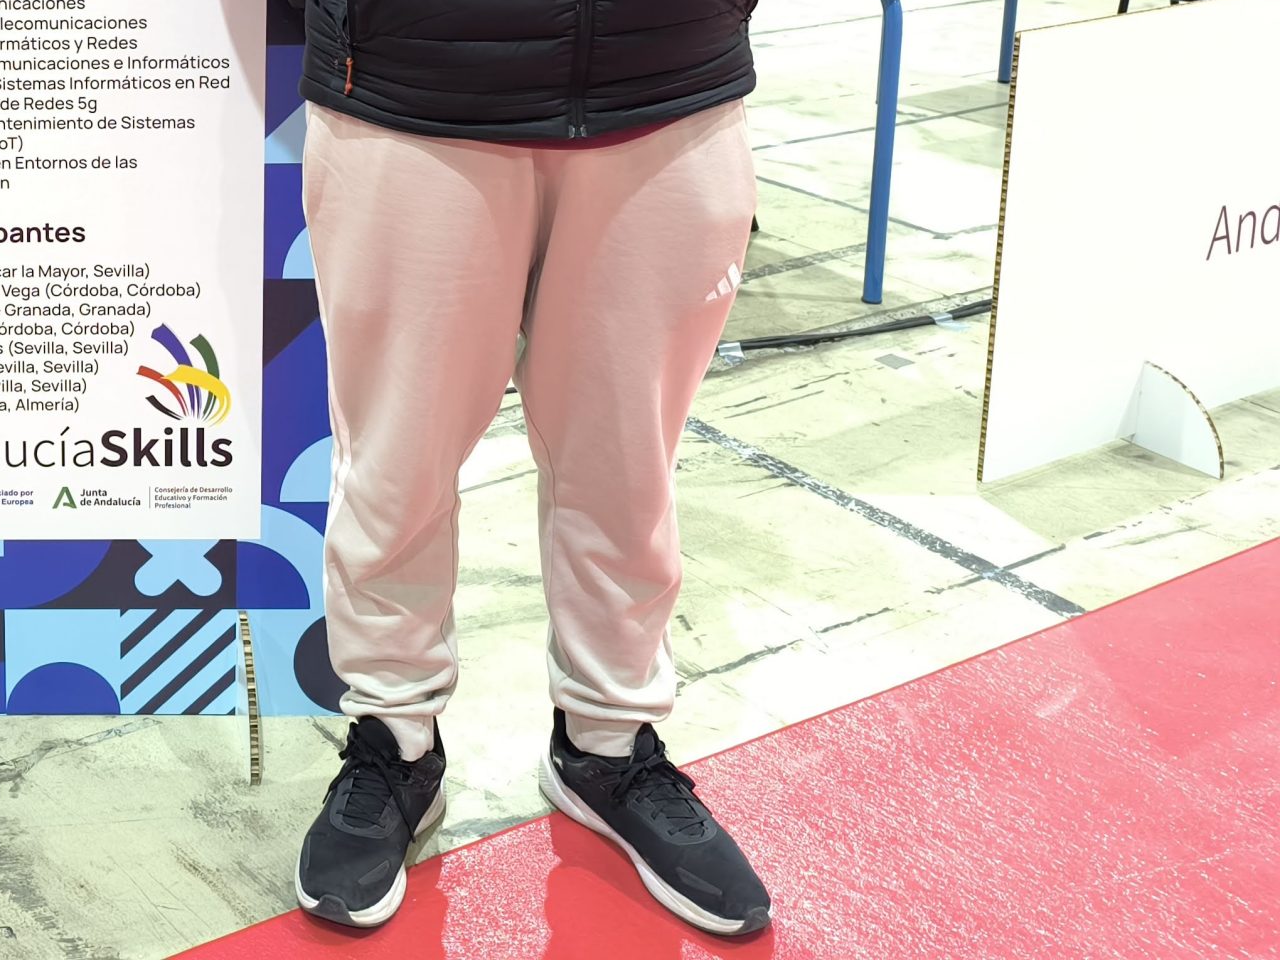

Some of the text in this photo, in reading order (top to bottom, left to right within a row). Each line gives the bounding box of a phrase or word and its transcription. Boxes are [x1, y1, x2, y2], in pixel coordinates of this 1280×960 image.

[74, 40, 83, 54] y
[87, 36, 138, 50] Redes
[114, 59, 123, 70] e
[128, 55, 230, 69] Informáticos
[70, 75, 171, 90] Informáticos
[175, 78, 195, 89] en
[199, 75, 230, 89] Red
[0, 97, 20, 111] de
[24, 97, 74, 110] Redes
[78, 96, 97, 114] 5g
[97, 116, 117, 130] de
[121, 116, 195, 129] Sistemas
[15, 156, 87, 169] Entornos
[91, 156, 111, 169] de
[115, 155, 138, 169] las
[22, 265, 34, 278] la
[38, 265, 88, 281] Mayor,
[94, 263, 150, 280] Sevilla)
[1, 284, 40, 301] Vega
[45, 283, 122, 299] (Córdoba,
[127, 282, 201, 299] Córdoba)
[4, 303, 75, 318] Granada,
[79, 301, 151, 318] Granada)
[61, 320, 135, 337] Córdoba)
[9, 340, 68, 357] (Sevilla,
[73, 339, 128, 356] Sevilla)
[43, 359, 99, 375] Sevilla)
[31, 378, 87, 394] Sevilla)
[15, 397, 79, 413] Almería)
[80, 489, 107, 497] Junta
[154, 486, 189, 494] Consejería
[1, 498, 34, 506] Europea
[80, 497, 141, 506] de Andalucía
